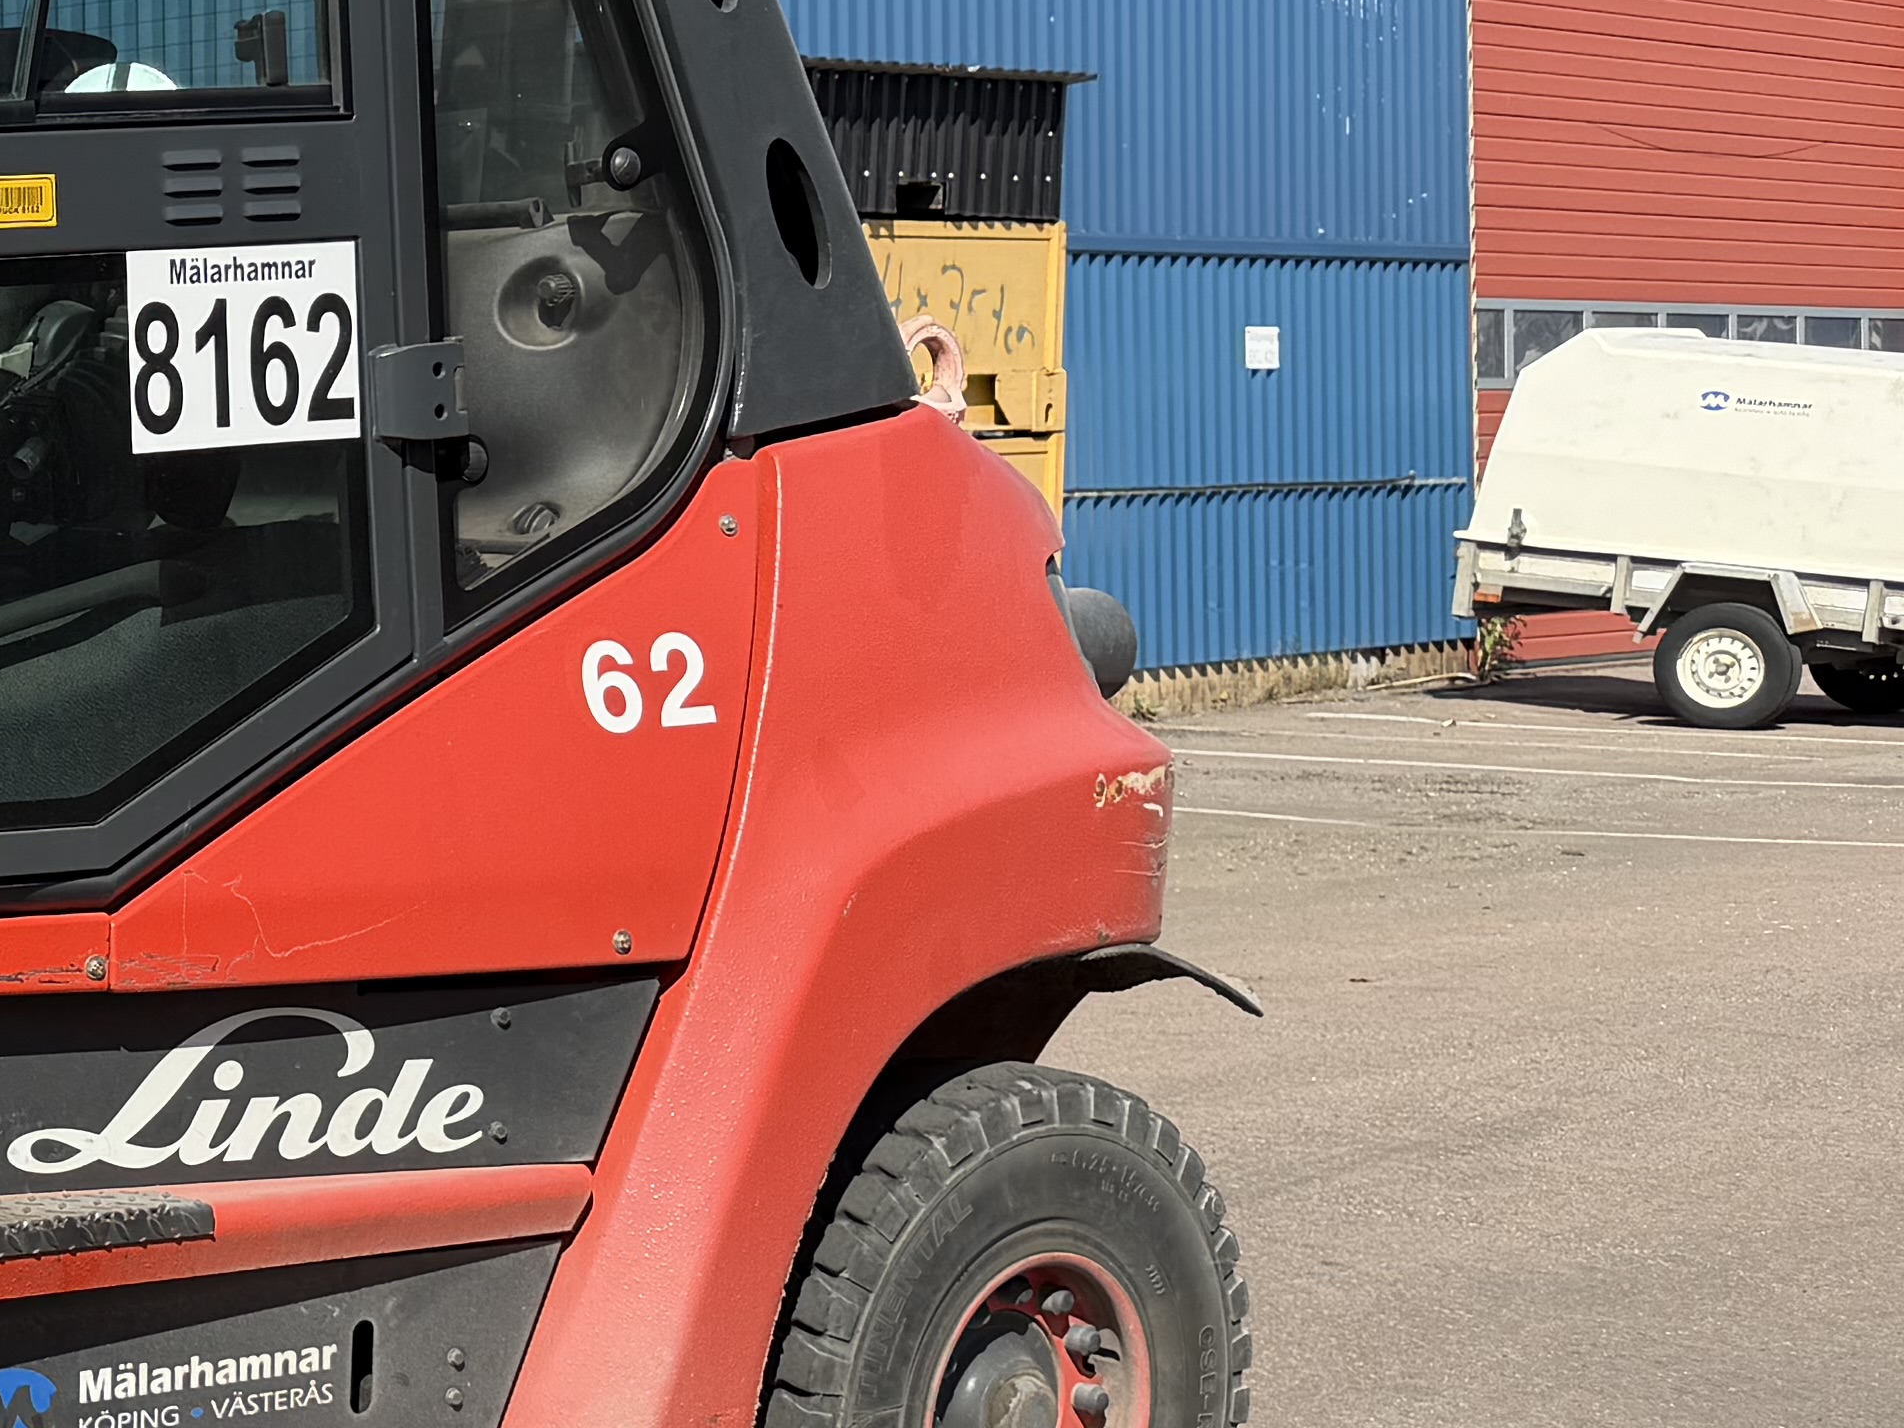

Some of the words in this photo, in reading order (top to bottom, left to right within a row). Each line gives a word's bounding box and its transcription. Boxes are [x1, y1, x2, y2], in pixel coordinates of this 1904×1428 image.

[169, 255, 317, 286] Mälarhamnar
[133, 292, 356, 436] 8162
[581, 630, 718, 735] 62
[6, 1006, 485, 1175] Linde
[78, 1343, 338, 1405] Mälarhamnar
[210, 1382, 334, 1420] VÄSTERÅS
